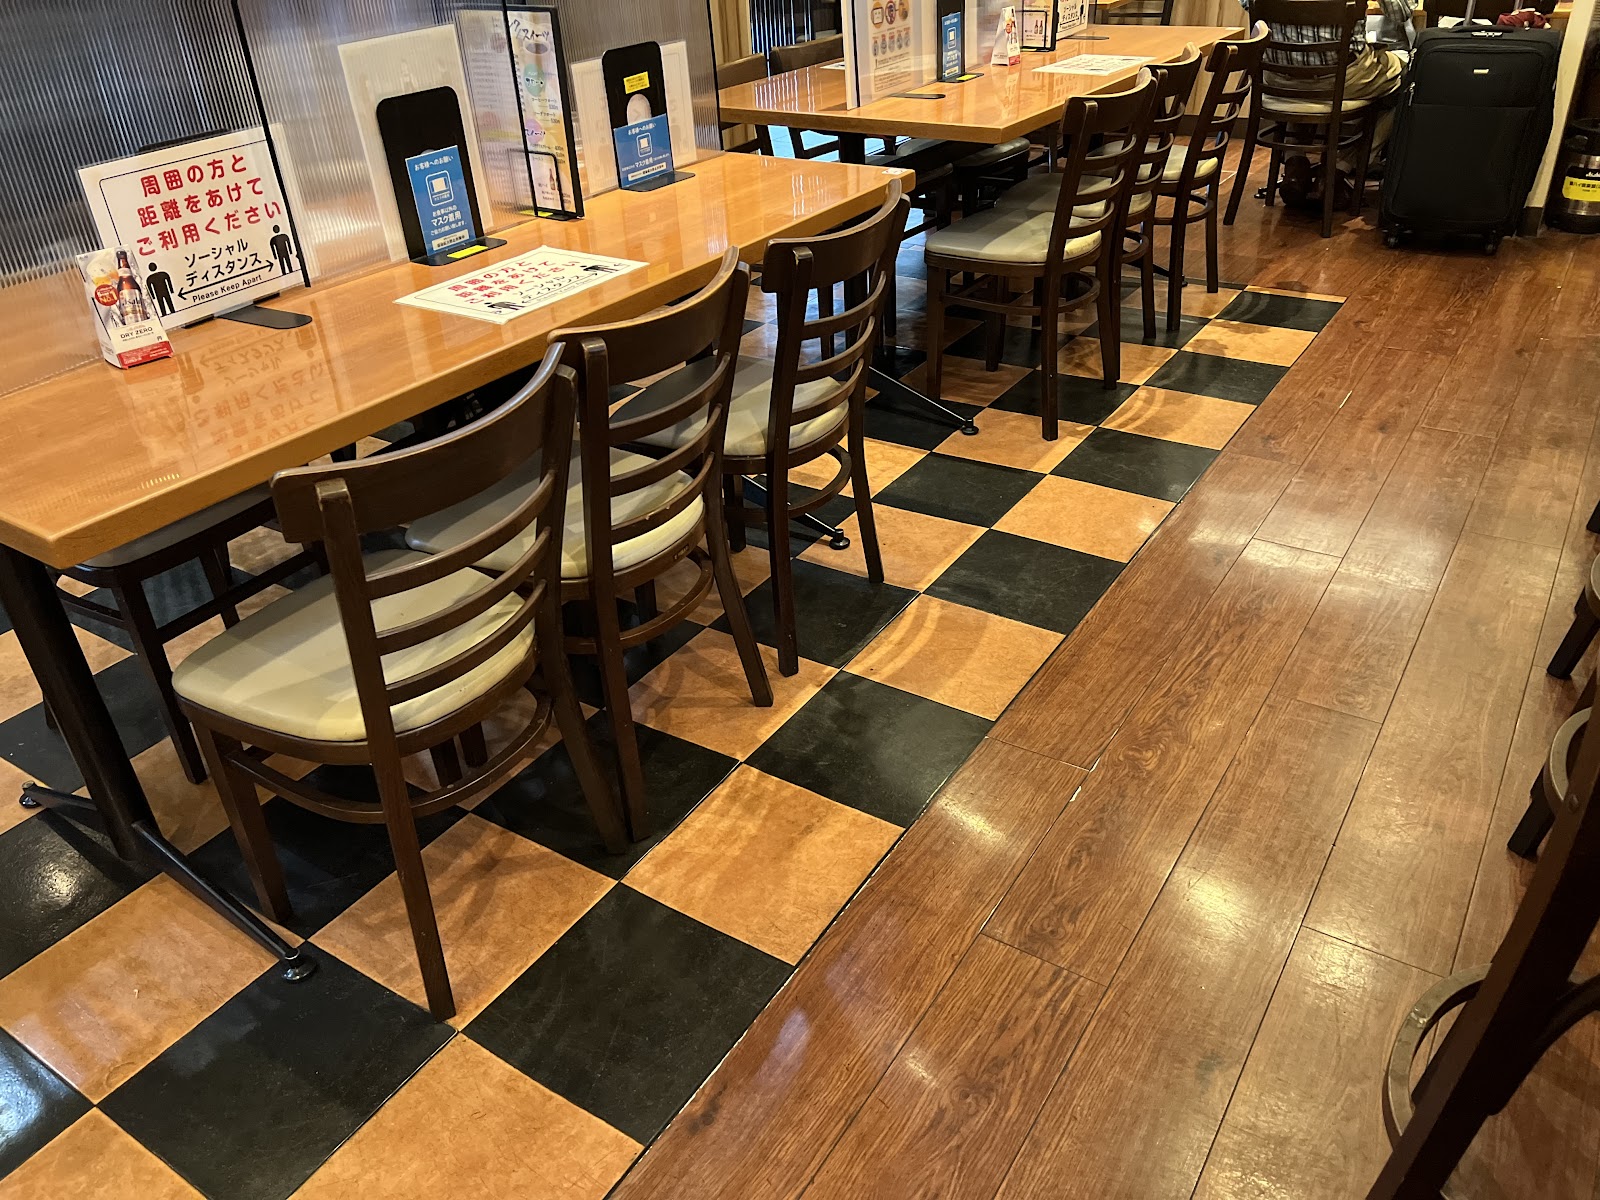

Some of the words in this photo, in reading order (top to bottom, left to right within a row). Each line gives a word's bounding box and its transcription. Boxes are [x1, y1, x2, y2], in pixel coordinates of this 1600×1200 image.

[140, 154, 247, 197] 周囲の方と
[137, 178, 264, 228] 距離をあけて
[431, 211, 462, 226] マスク着用
[136, 201, 282, 256] ご利用ください
[184, 238, 248, 268] ソーシャル
[186, 252, 262, 287] ディスタンス
[192, 288, 219, 302] Please
[220, 282, 240, 297] Keep
[242, 274, 262, 290] Apart
[135, 326, 153, 335] ZERO
